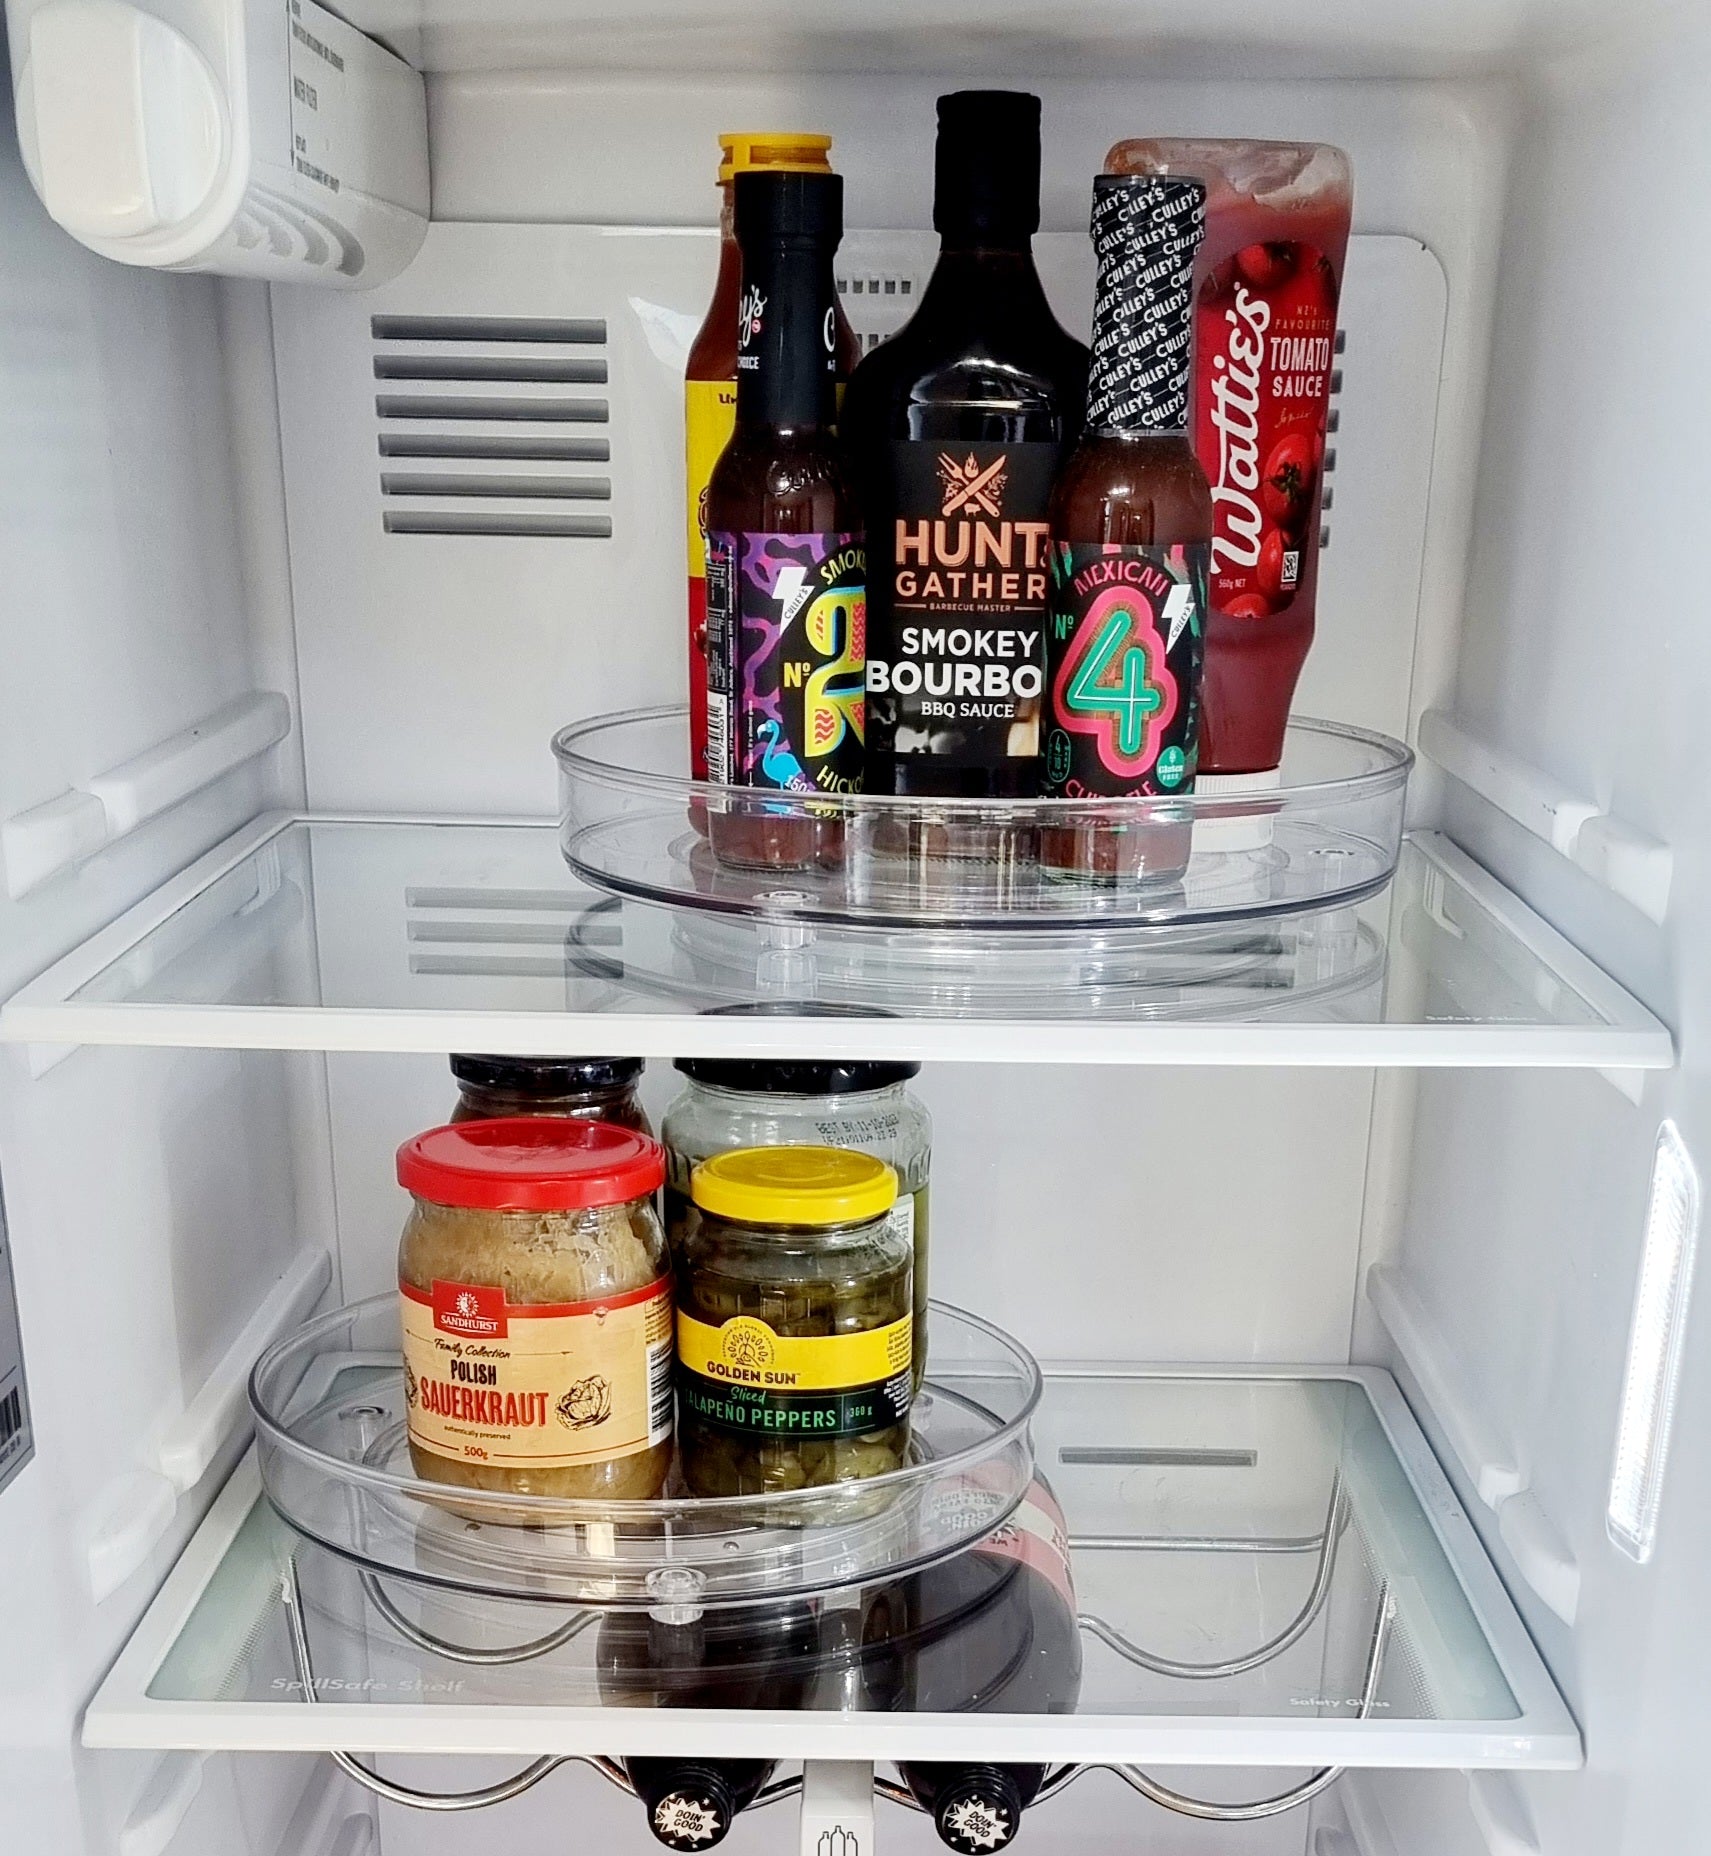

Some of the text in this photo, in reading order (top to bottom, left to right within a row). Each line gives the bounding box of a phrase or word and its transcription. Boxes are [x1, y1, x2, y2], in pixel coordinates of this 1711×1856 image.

[1152, 188, 1199, 222] CULLEY'S
[1125, 222, 1177, 254] CULLEY'S
[1136, 254, 1181, 288] CULLEY'S
[1144, 289, 1188, 322] CULLEY'S
[1275, 319, 1330, 331] FAVOURITE
[1118, 322, 1168, 357] CULLEY'S
[1270, 337, 1330, 372] TOMATO
[1130, 357, 1178, 391] CULLEY'S
[1272, 376, 1323, 397] SAUCE
[1142, 391, 1184, 425] CULLEY'S
[1210, 286, 1270, 574] Wattie's
[896, 519, 1049, 568] HUNT
[895, 572, 1046, 600] GATHER
[784, 586, 809, 620] CULLEY'S
[929, 603, 1011, 613] BARBECUE MASTER
[902, 628, 1039, 657] SMOKEY
[866, 660, 1042, 698] BOURBO
[1060, 598, 1169, 766] 4
[921, 701, 1015, 718] BBQ SAUCE
[440, 1315, 499, 1331] SANDHURST
[434, 1338, 511, 1359] Family Collection
[451, 1359, 497, 1385] POLISH
[707, 1360, 760, 1383] GOLDEN
[420, 1376, 550, 1427] SAUERKRAUT
[731, 1386, 767, 1405] Sliced
[751, 1410, 836, 1428] PEPPERS
[479, 1431, 511, 1441] preserved
[464, 1446, 488, 1460] 500g
[271, 1677, 466, 1693] SpllSafe Shelf
[1290, 1697, 1340, 1708] Safety
[674, 1819, 703, 1832] GOOD
[675, 1810, 706, 1822] DOIN'
[963, 1819, 990, 1837] GOOD
[969, 1811, 997, 1828] DOIN'
